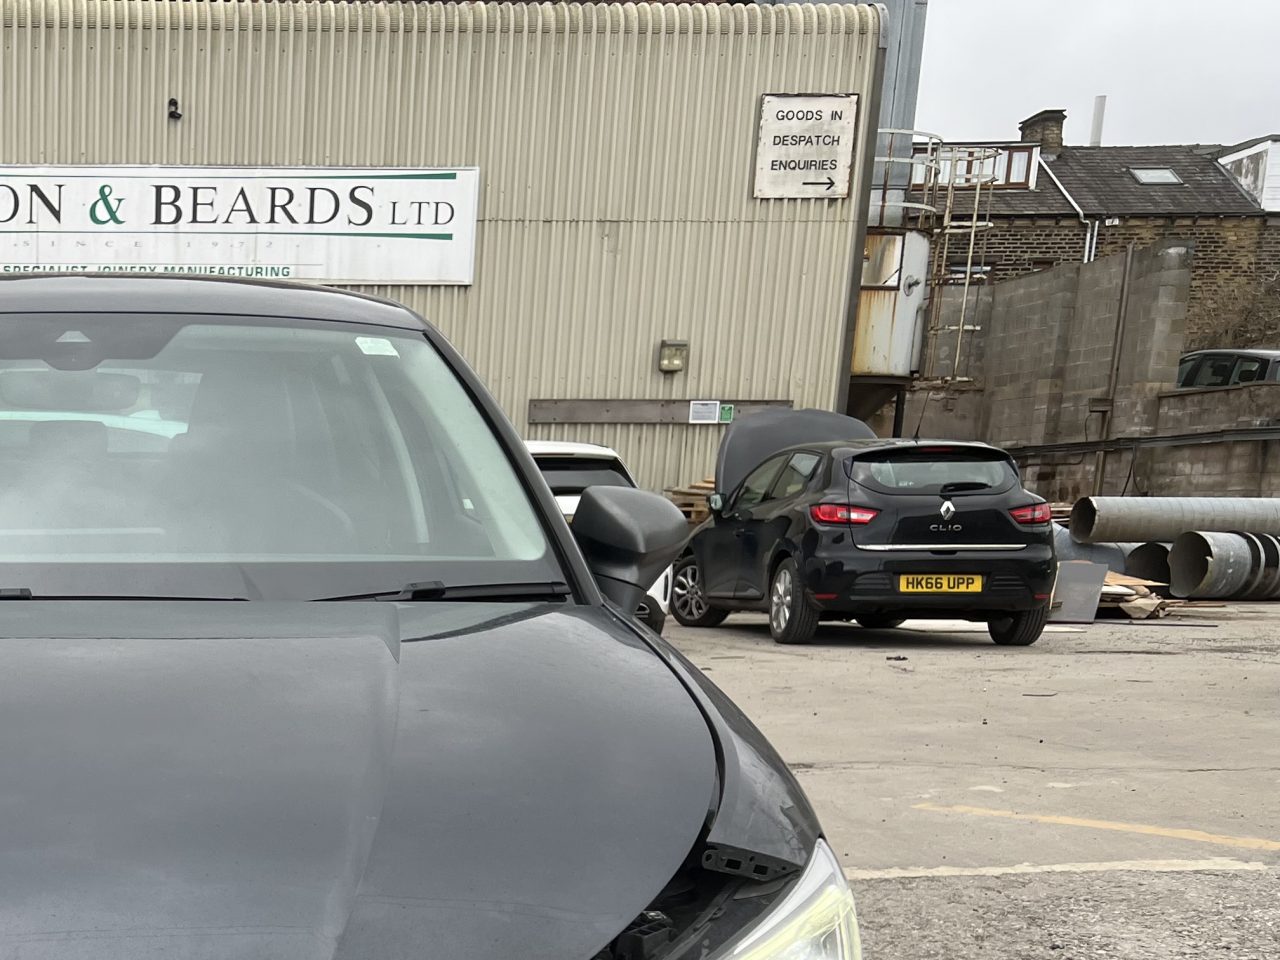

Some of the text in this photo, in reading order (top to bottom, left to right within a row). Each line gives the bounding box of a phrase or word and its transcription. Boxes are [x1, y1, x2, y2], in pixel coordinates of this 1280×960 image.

[776, 110, 843, 121] GOODS IN
[772, 135, 841, 146] DESPATCH
[770, 160, 838, 171] ENQUIRIES
[89, 184, 126, 225] &
[150, 184, 375, 226] BEARDS
[388, 201, 455, 226] LTD
[929, 524, 962, 532] CLIO
[905, 576, 975, 590] HK66 UPP
